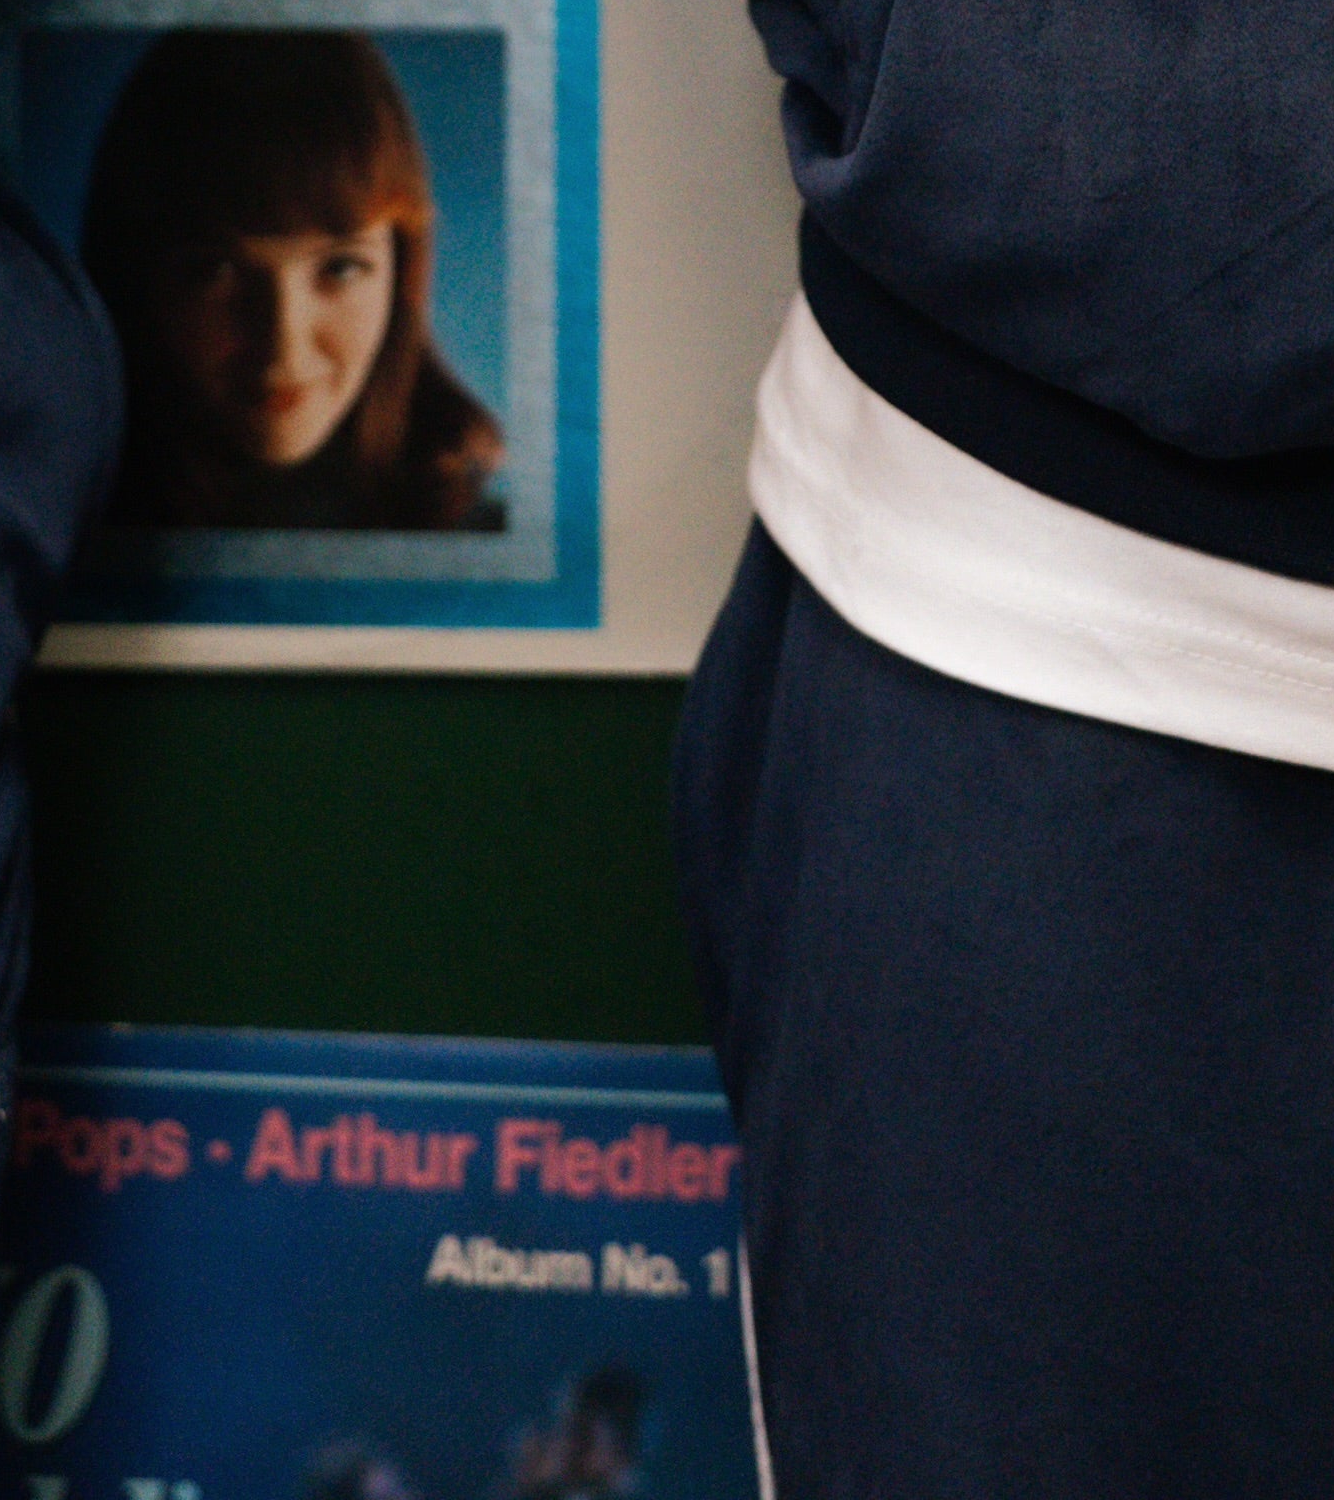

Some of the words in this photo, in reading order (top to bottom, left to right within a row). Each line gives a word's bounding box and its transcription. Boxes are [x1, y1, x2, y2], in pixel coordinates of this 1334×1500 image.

[17, 1103, 190, 1192] Pops
[245, 1107, 479, 1192] Arthur
[494, 1117, 741, 1201] Fiedler
[427, 1234, 594, 1294] Album
[600, 1242, 689, 1296] No.
